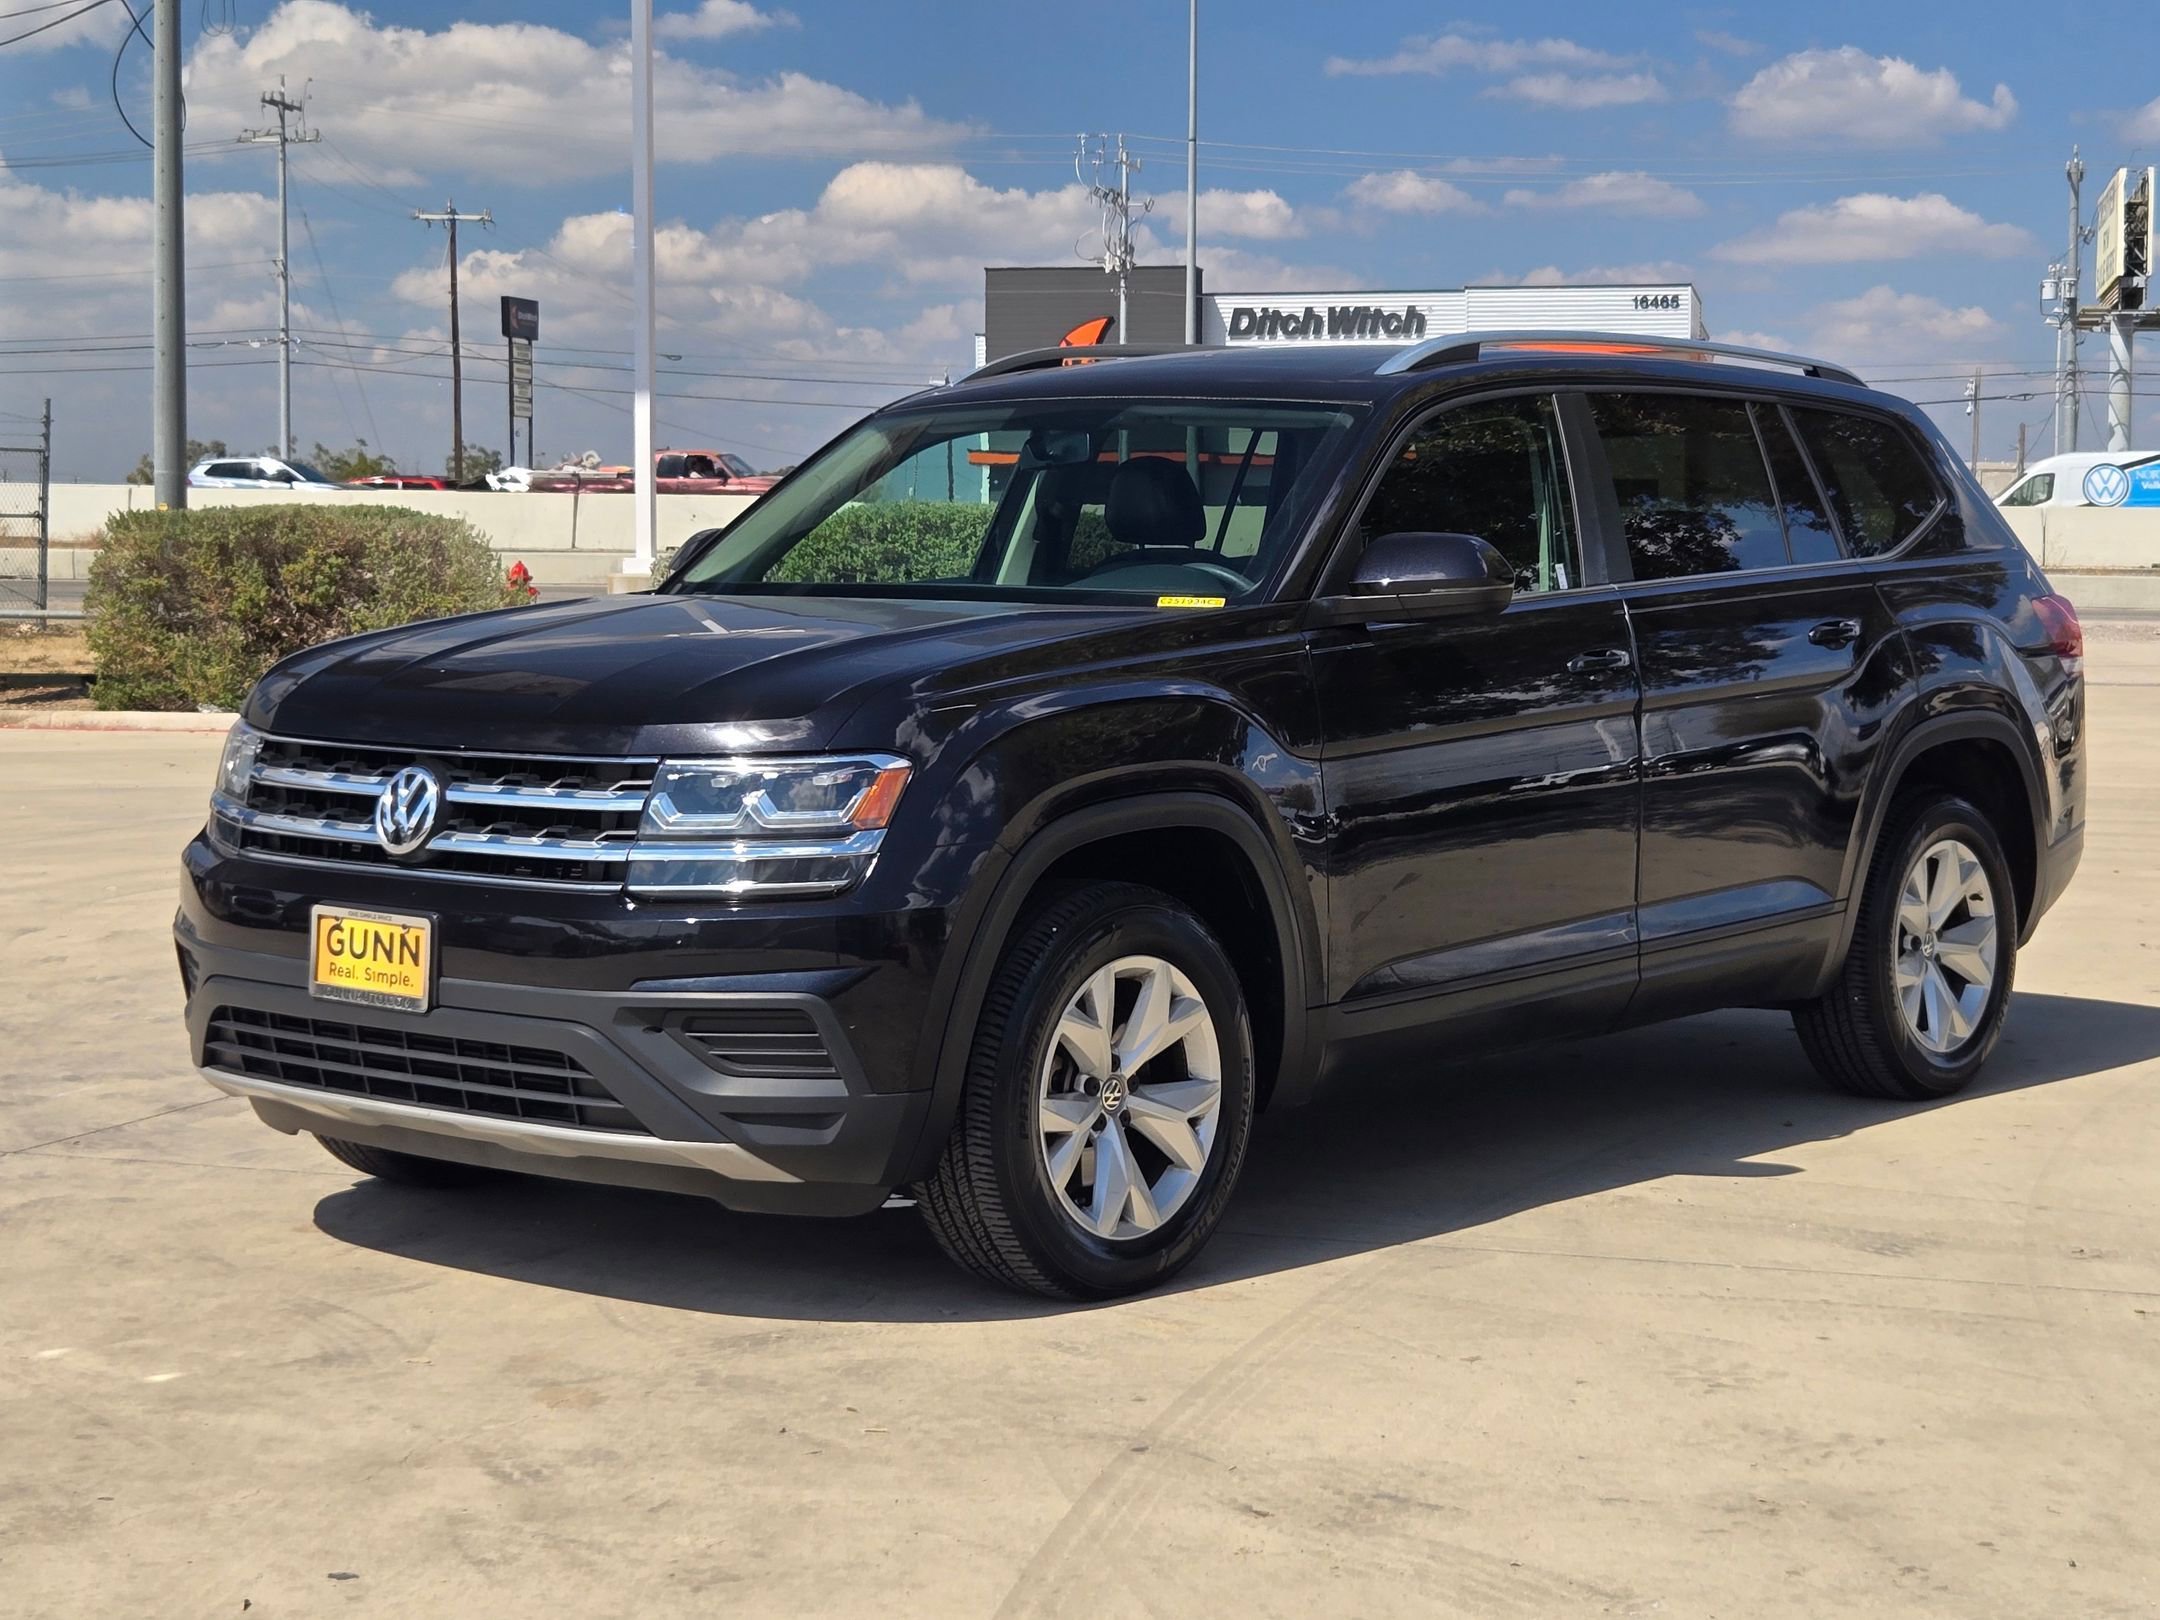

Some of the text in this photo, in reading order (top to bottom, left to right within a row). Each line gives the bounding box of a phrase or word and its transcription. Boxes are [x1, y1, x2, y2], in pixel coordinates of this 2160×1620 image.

[1228, 305, 1426, 337] Ditch Witch
[327, 923, 420, 967] GUNN
[328, 962, 414, 988] Real. Simple.
